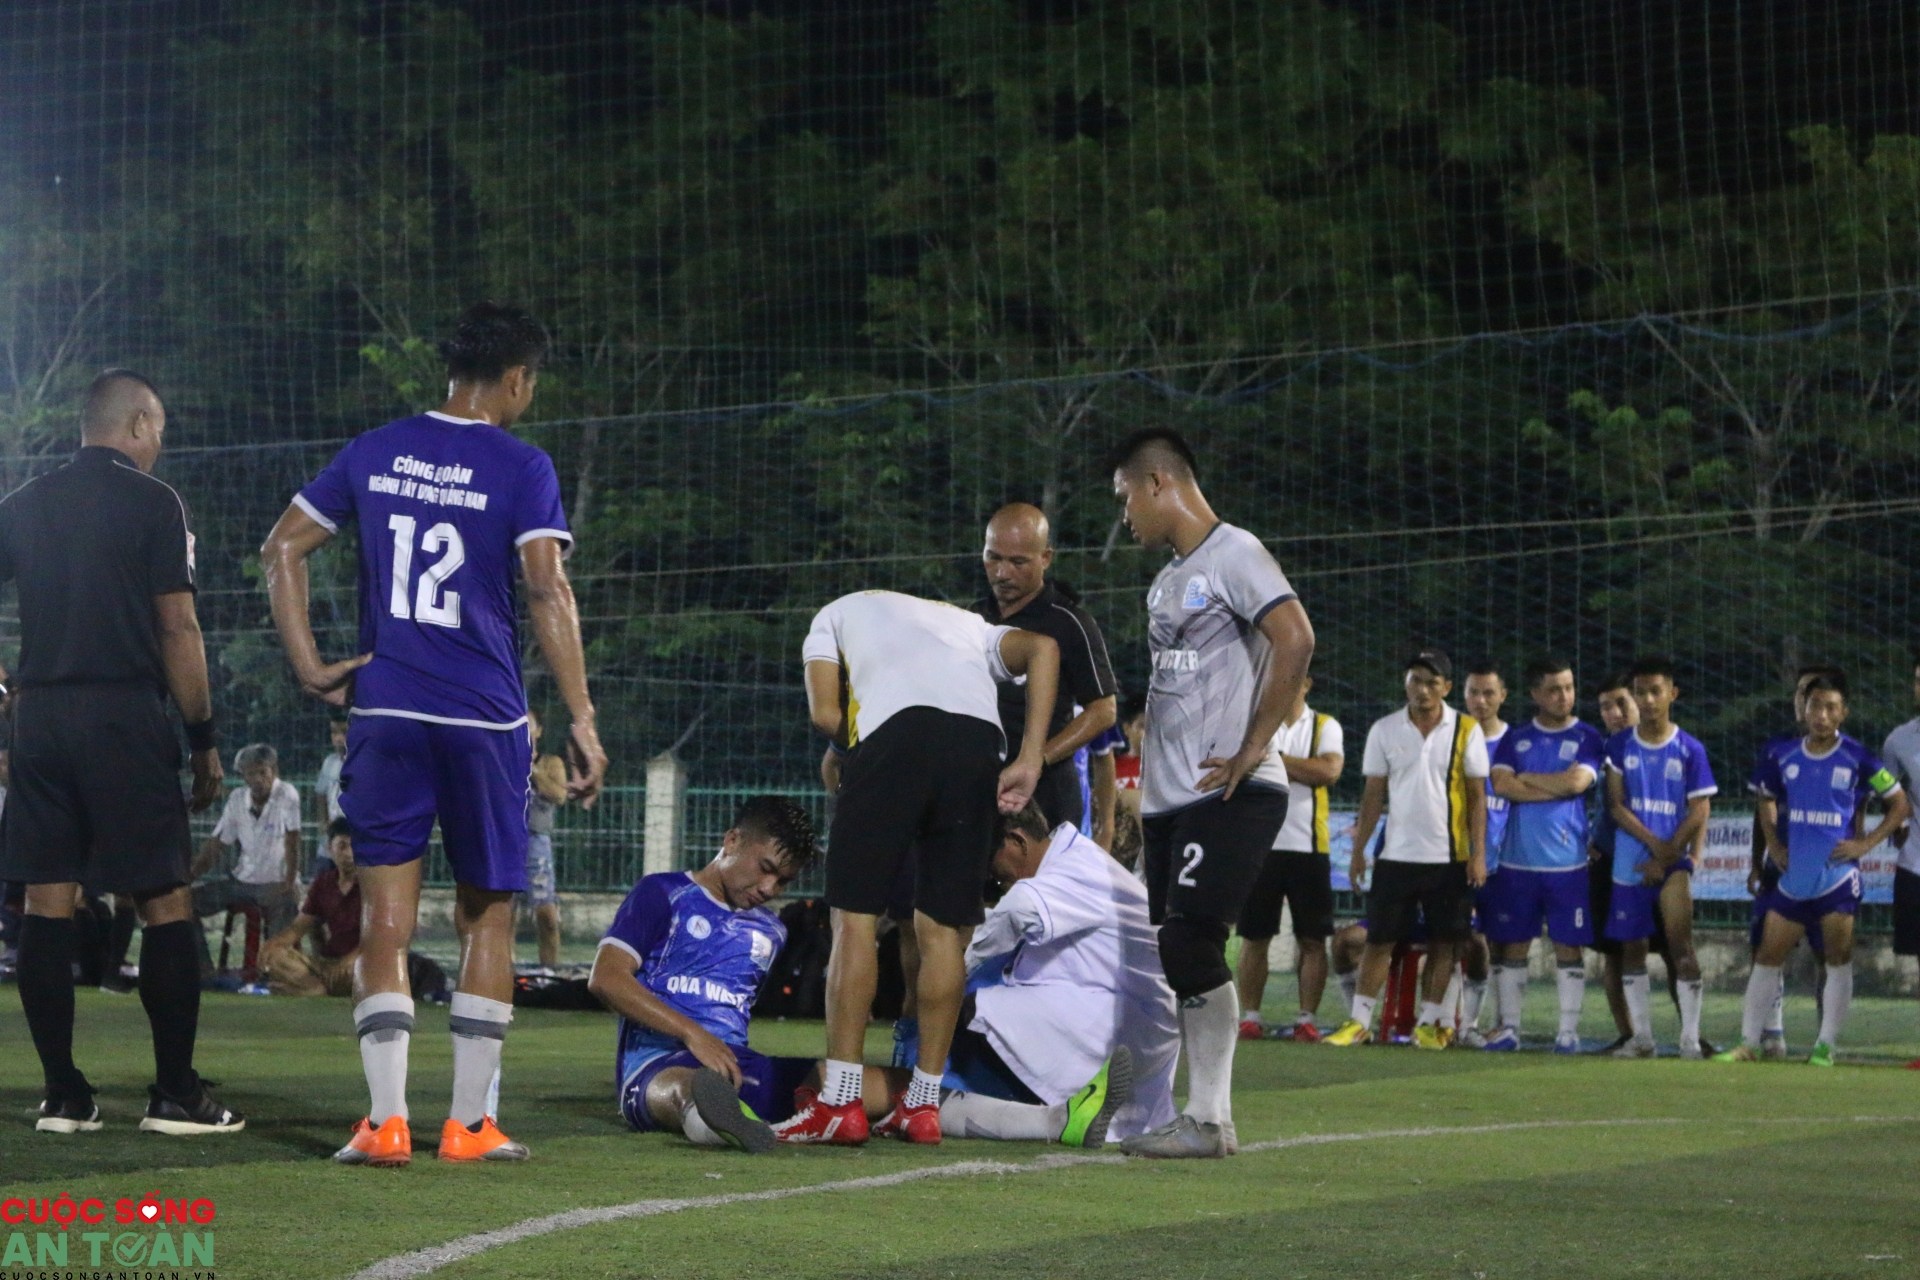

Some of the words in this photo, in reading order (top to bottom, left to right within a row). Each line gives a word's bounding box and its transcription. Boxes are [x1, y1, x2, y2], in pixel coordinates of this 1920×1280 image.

[392, 455, 435, 481] CÔNG
[433, 463, 473, 486] ĐOÀN
[399, 478, 418, 498] XÂY
[463, 490, 488, 511] NAM
[388, 514, 465, 629] 12
[1807, 810, 1842, 827] WATER
[1178, 843, 1204, 887] 2
[666, 976, 700, 995] QNA
